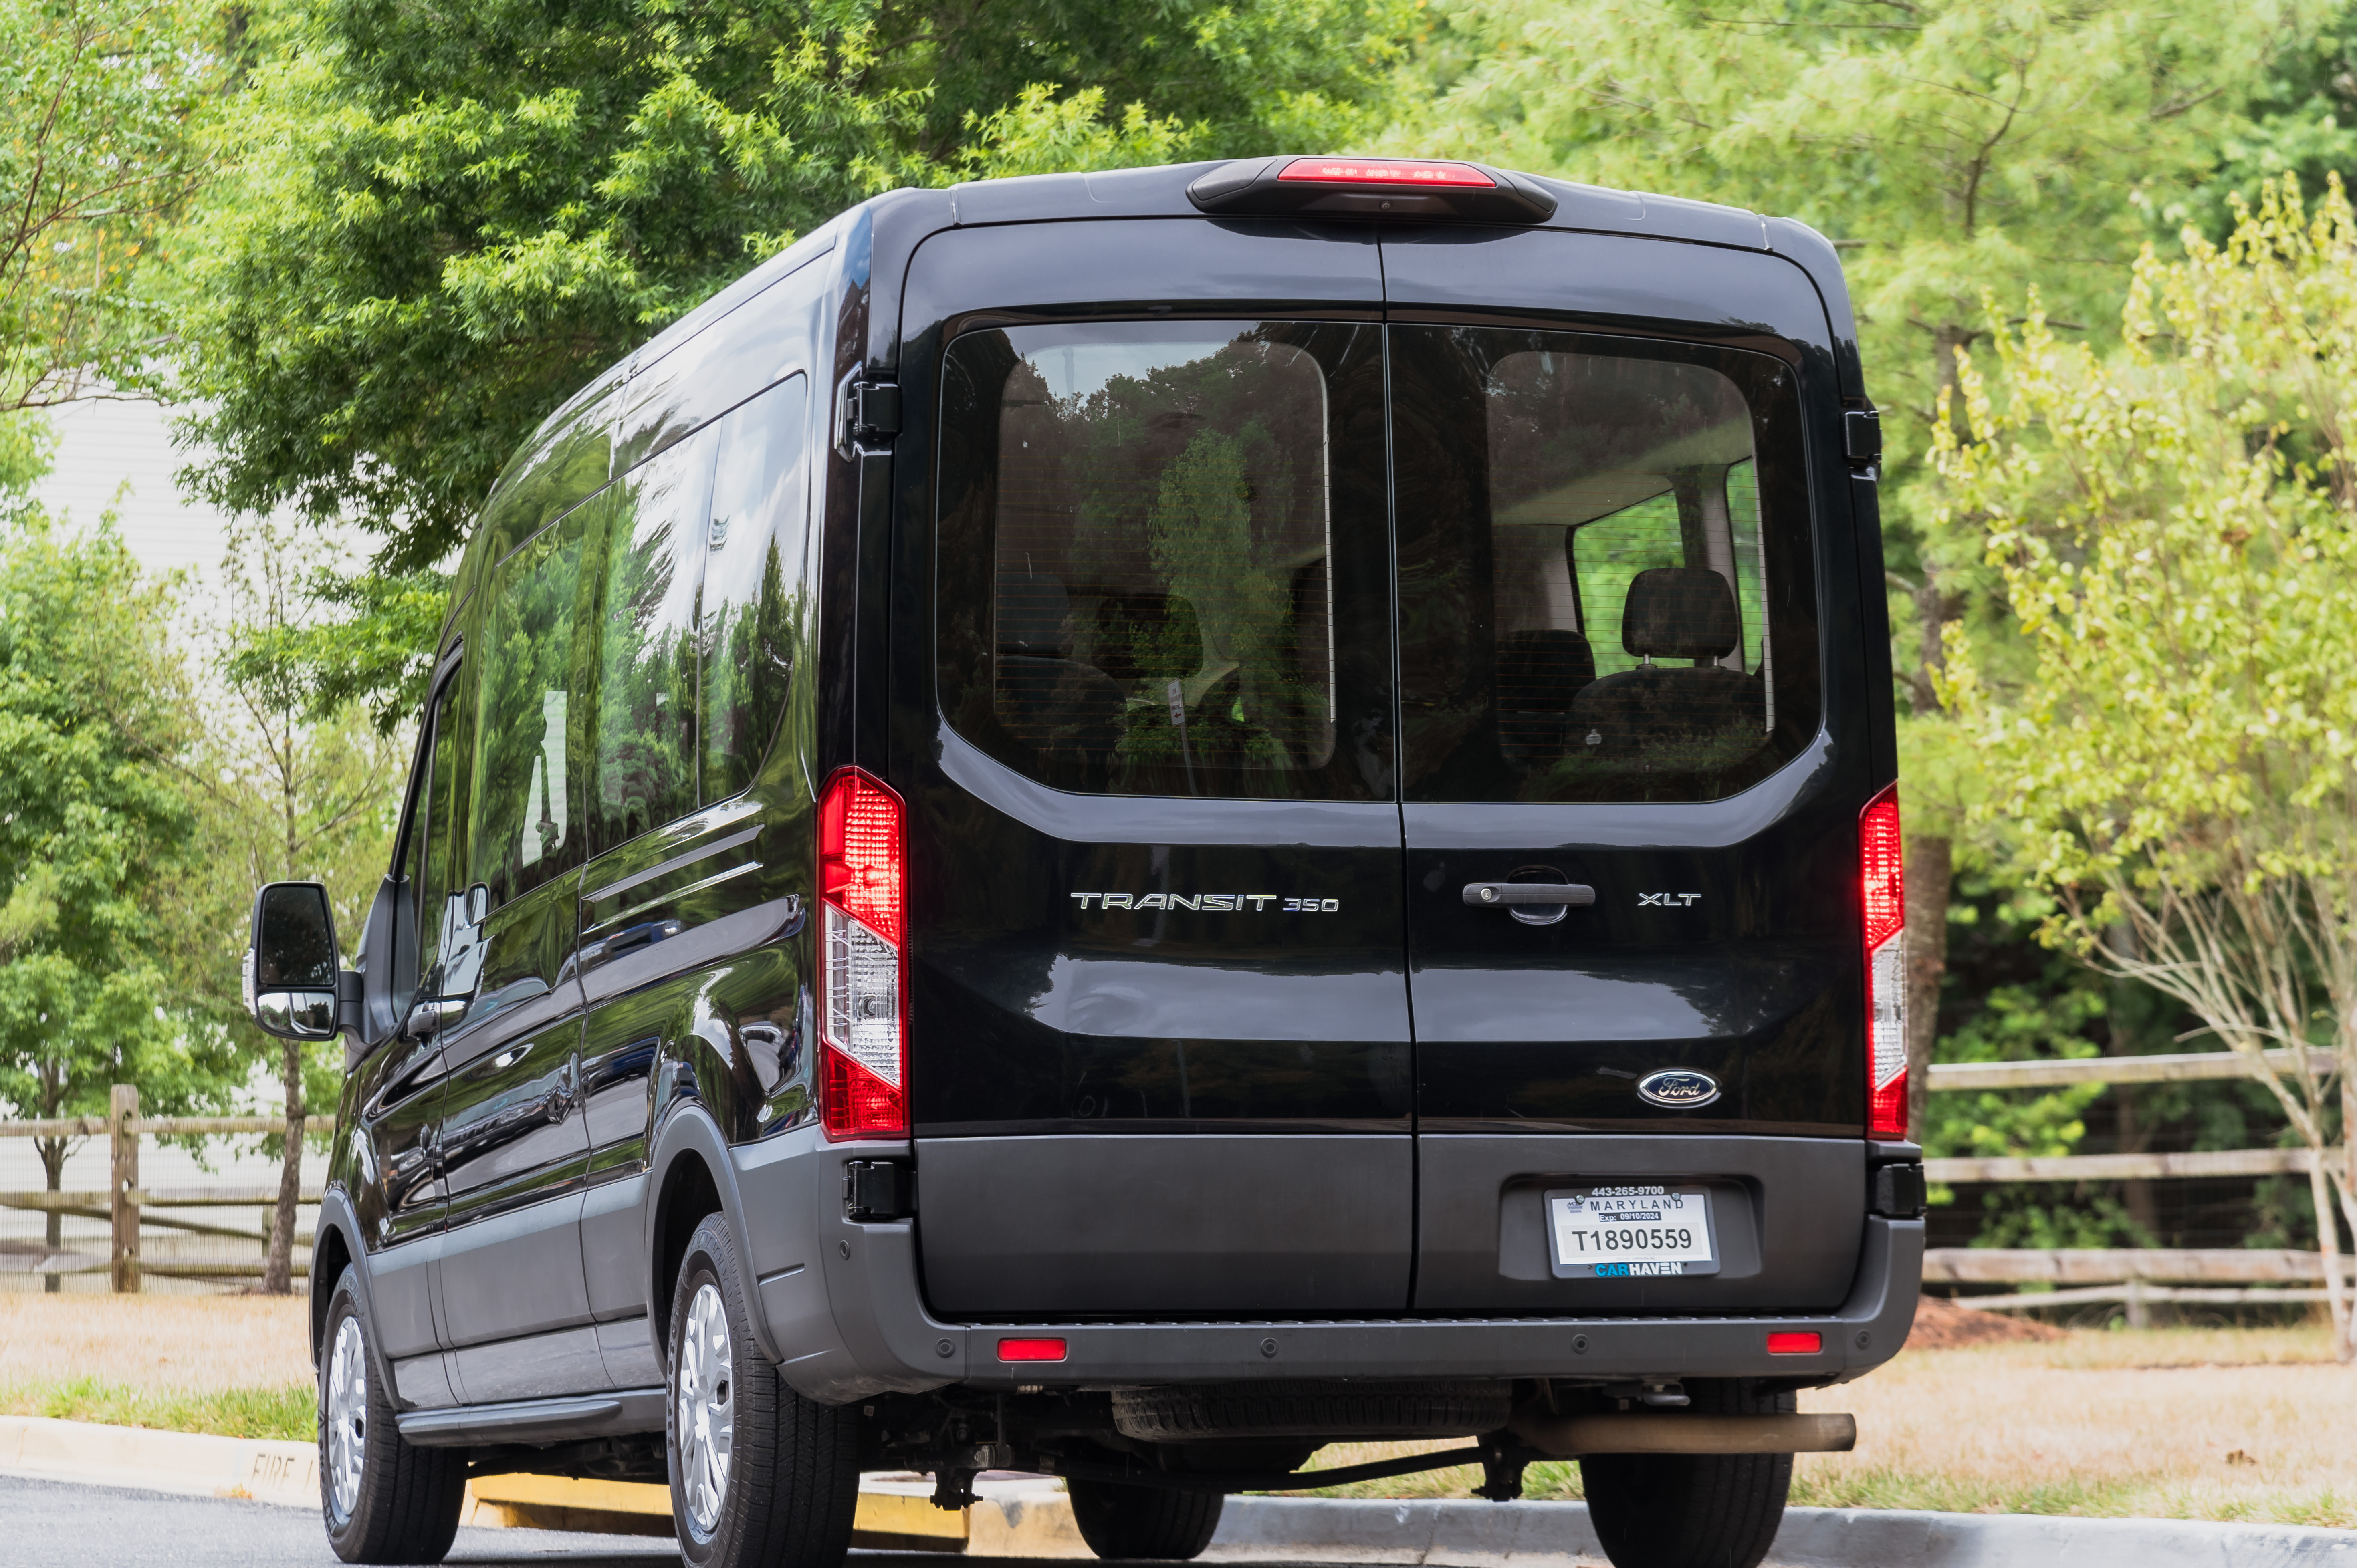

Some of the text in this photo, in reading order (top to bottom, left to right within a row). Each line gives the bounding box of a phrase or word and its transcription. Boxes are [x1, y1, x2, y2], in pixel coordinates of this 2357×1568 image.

[1070, 893, 1339, 912] TRANSIT 350
[1637, 893, 1701, 906] XLT
[1658, 1077, 1700, 1096] Ford
[1592, 1186, 1664, 1196] 443-265-9700
[1590, 1199, 1684, 1211] MARYLAND
[1599, 1212, 1659, 1222] Exp: 09/10/2024
[1572, 1228, 1692, 1251] T1890559
[1595, 1262, 1683, 1277] CARHAVEN
